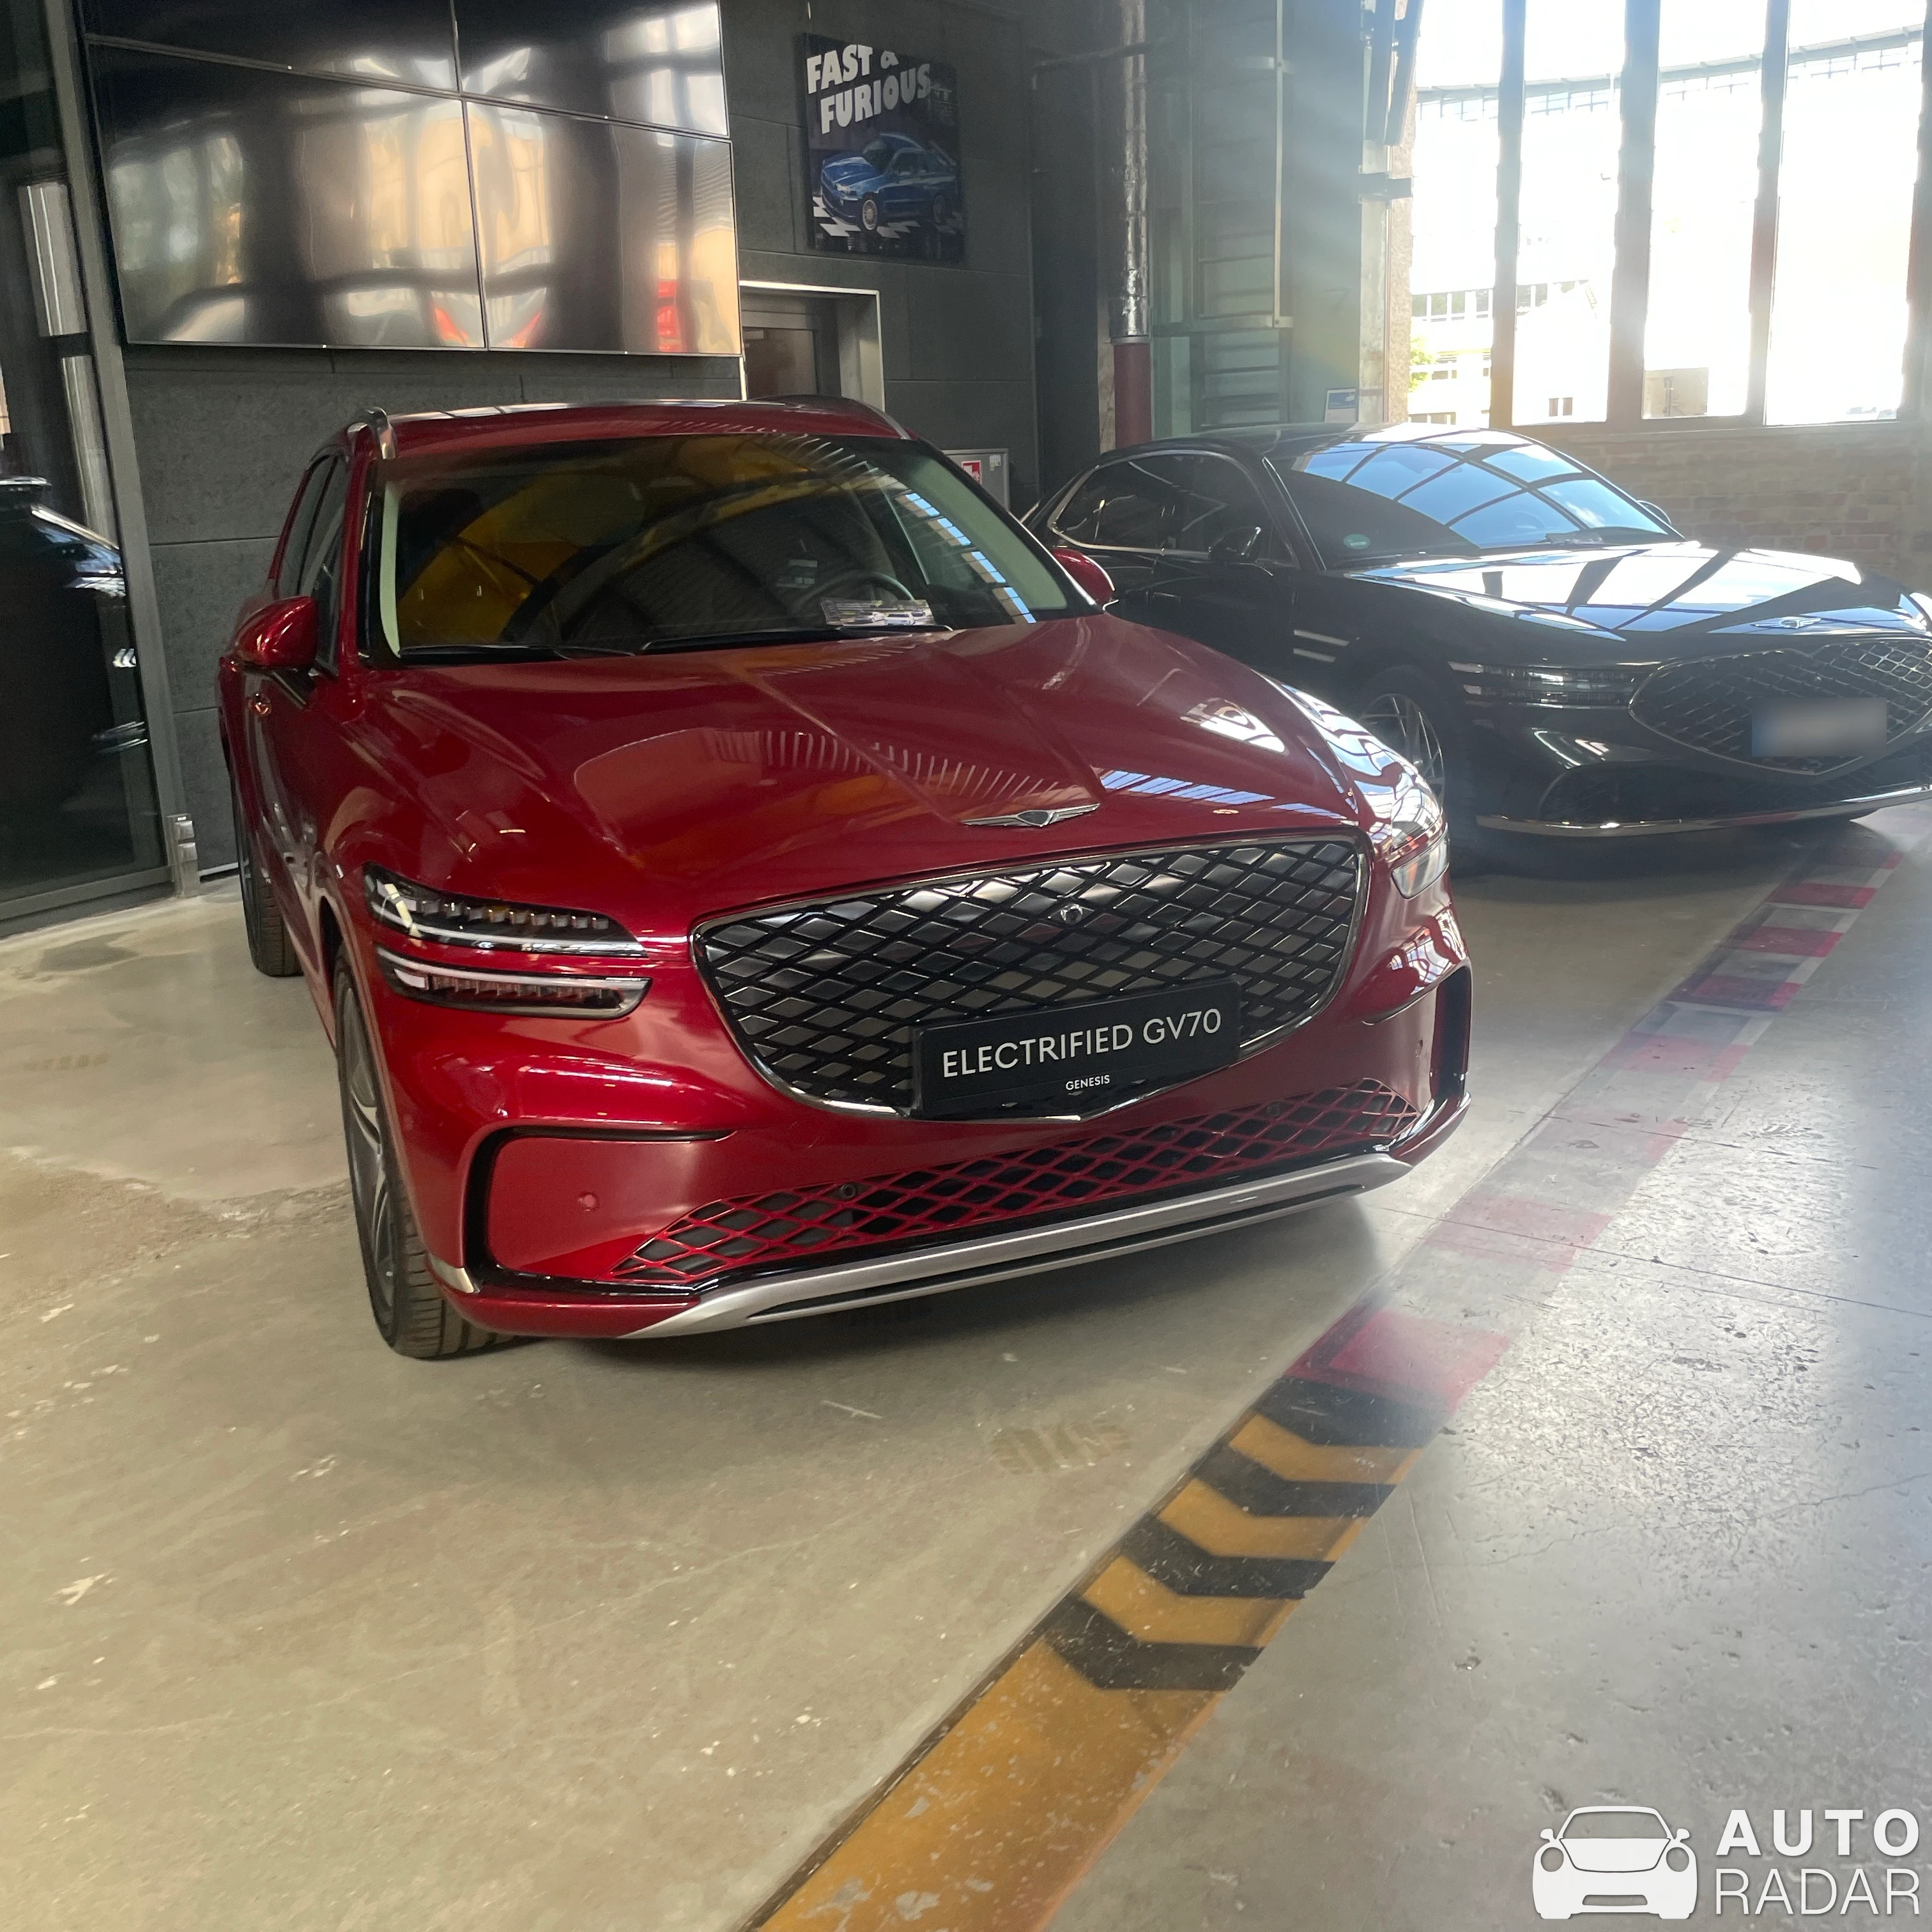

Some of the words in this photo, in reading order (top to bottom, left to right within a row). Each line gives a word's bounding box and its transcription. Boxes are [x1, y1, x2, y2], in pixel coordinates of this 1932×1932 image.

[807, 44, 873, 94] FAST
[820, 63, 931, 134] FURIOUS
[943, 1025, 1133, 1078] ELECTRIFIED
[1142, 1008, 1222, 1044] GV70
[1065, 1075, 1110, 1091] GENESIS
